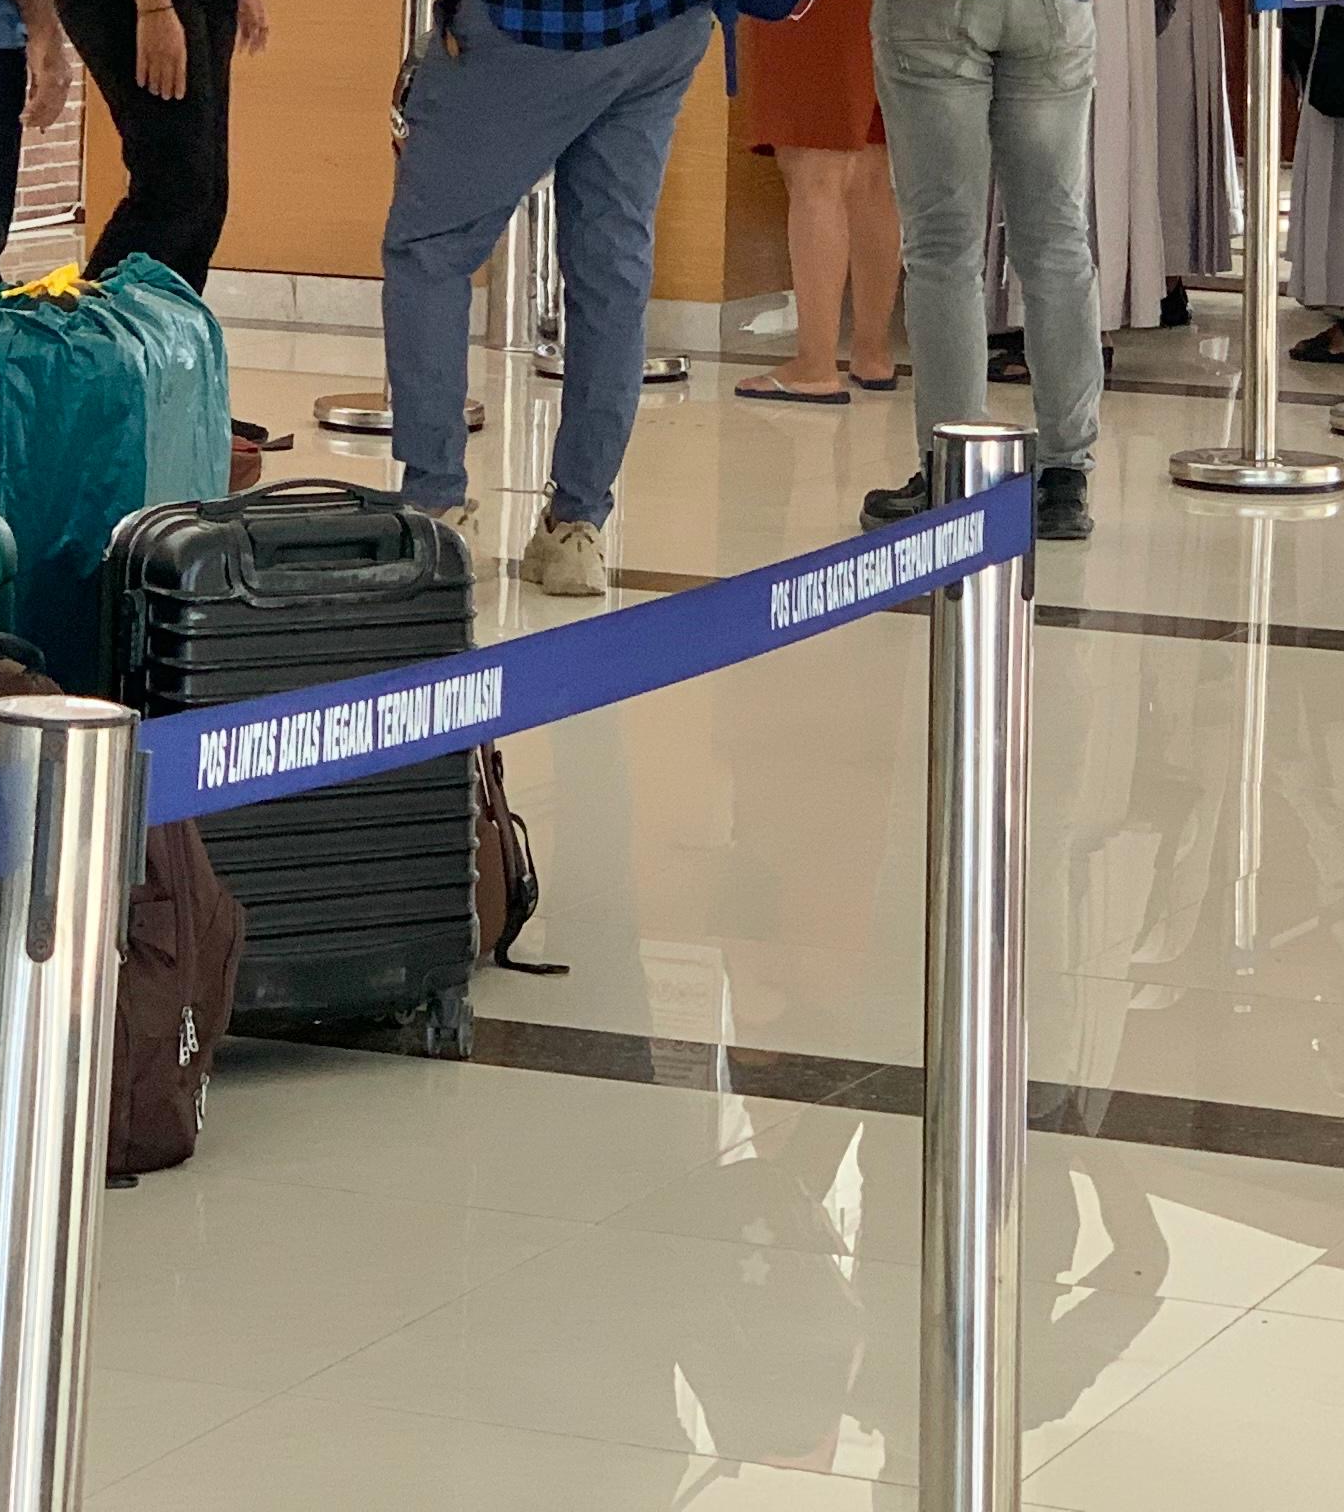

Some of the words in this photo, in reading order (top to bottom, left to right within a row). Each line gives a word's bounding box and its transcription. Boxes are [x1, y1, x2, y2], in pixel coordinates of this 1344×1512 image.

[771, 580, 790, 630] POS
[792, 569, 825, 623] LINTAS
[826, 558, 855, 611] BATAS
[857, 545, 893, 600] NEGARA
[895, 529, 933, 586] TERPADU
[198, 729, 227, 790] POS
[228, 719, 277, 784] LINTAS
[278, 710, 321, 773] BATAS
[323, 699, 373, 762] NEGARA
[377, 685, 431, 749] TERPADU
[433, 666, 503, 735] MOTAMASIN
